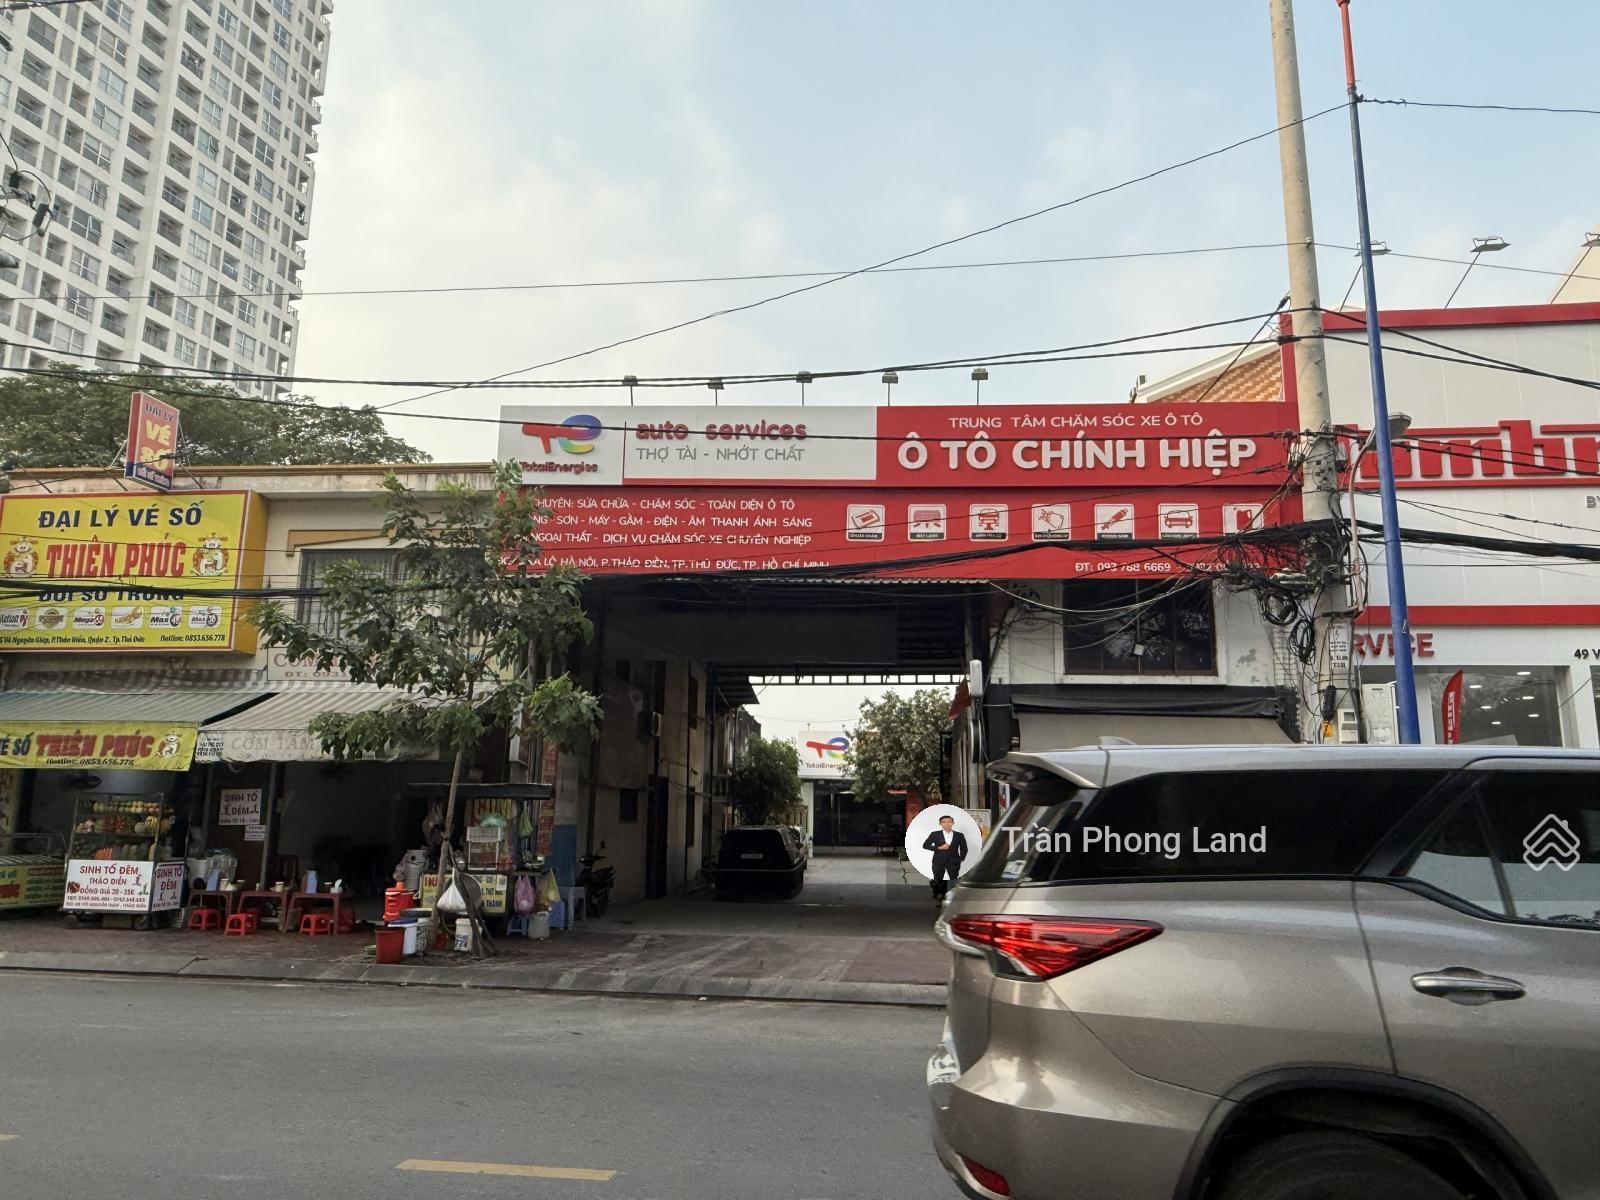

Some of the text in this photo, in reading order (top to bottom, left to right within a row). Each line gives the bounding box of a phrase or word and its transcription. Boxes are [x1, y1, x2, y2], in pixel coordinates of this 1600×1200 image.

[948, 411, 1204, 429] TRUNG TÂM CHĂM SÓC XE Ô TÔ
[145, 419, 171, 446] VÉ
[635, 419, 808, 441] auto services
[636, 446, 669, 463] THỢ
[676, 444, 697, 461] TÀI
[716, 444, 759, 461] NHỚT
[764, 443, 805, 461] CHẤT
[897, 428, 1257, 476] Ô TÔ CHÍNH HIỆP
[519, 460, 599, 475] TotalEnergies
[534, 497, 574, 509] HUYÊN:
[577, 497, 598, 509] SỬA
[601, 497, 630, 509] CHỮA
[640, 498, 671, 509] CHĂM
[674, 497, 696, 509] SÓC
[708, 498, 736, 510] TOÀN
[740, 498, 764, 511] DIỆN
[767, 499, 777, 510] Ô
[780, 499, 795, 510] TÔ
[38, 500, 205, 534] ĐẠI LÝ VÉ SỐ
[556, 515, 579, 525] SƠN
[588, 515, 611, 526] MÁY
[653, 515, 678, 528] ĐIỆN
[711, 517, 749, 527] THANH
[753, 515, 777, 527] ÁNH
[782, 515, 813, 528] SÁNG
[565, 530, 593, 542] THẤT
[602, 534, 628, 545] DỊCH
[631, 534, 647, 545] VỤ
[650, 533, 681, 544] CHĂM
[684, 533, 706, 544] SÓC
[709, 534, 723, 545] XE
[774, 535, 812, 547] NGHIỆP
[46, 532, 187, 578] THIÊN PHÚC
[1097, 562, 1118, 572] 093
[1143, 562, 1172, 572] 6669
[1574, 648, 1589, 659] 49
[13, 731, 35, 756] SỐ
[100, 729, 156, 758] PHÚC
[80, 863, 139, 875] SINH TỐ ĐÊM
